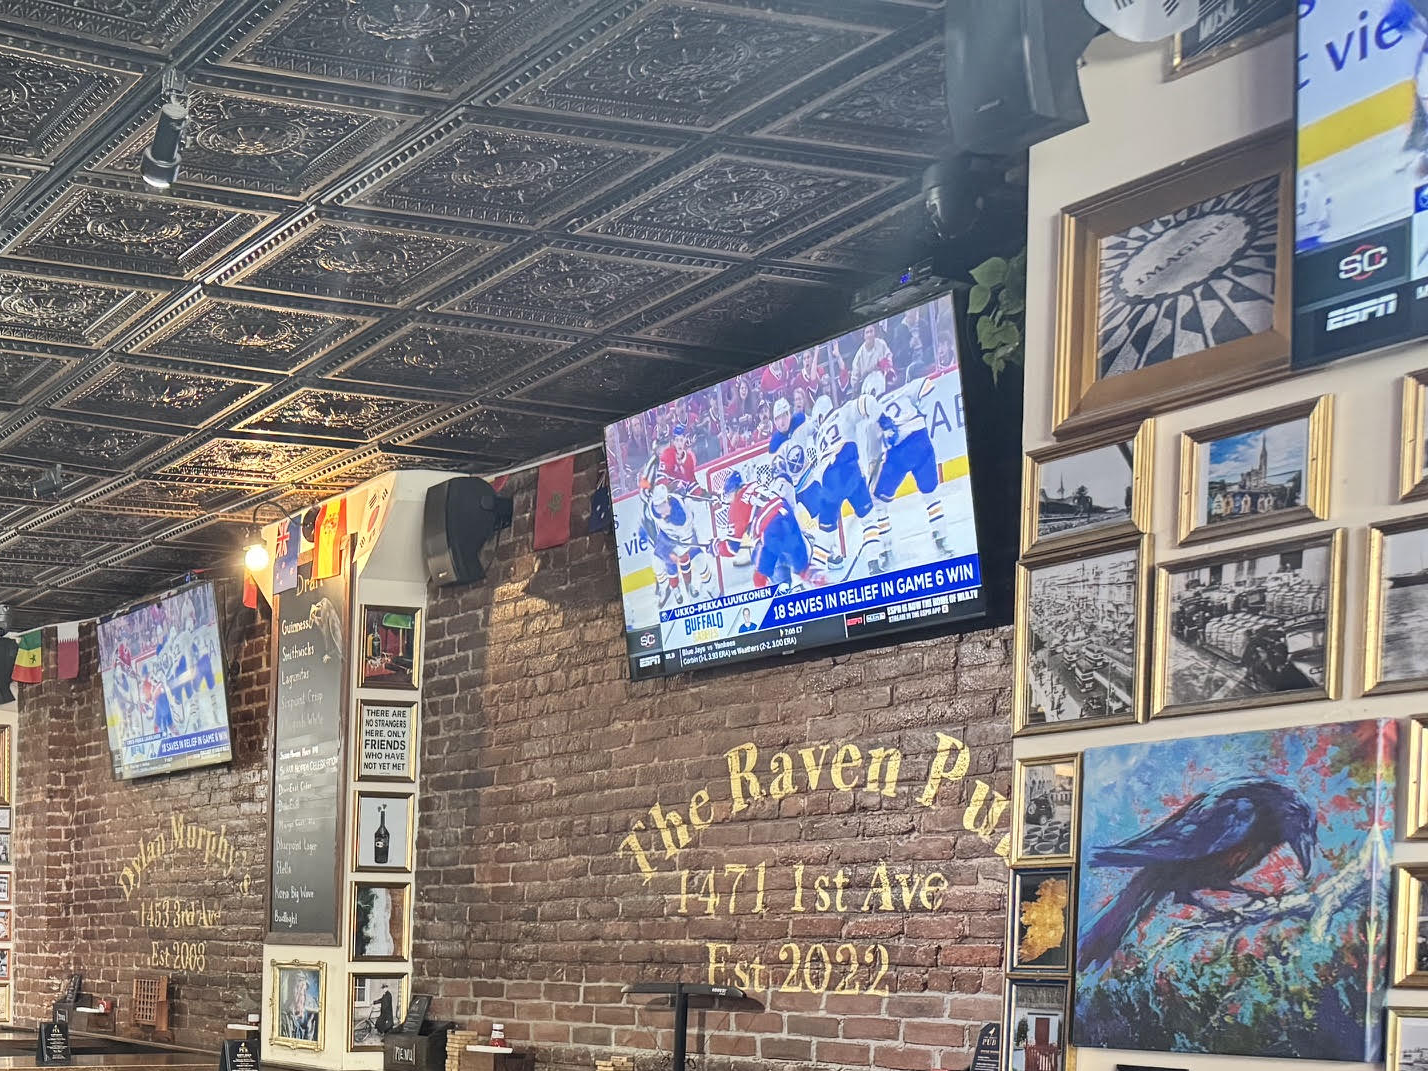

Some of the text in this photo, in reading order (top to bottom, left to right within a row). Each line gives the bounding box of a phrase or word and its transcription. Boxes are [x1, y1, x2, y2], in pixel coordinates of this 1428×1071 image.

[1136, 221, 1232, 285] IMAGINE
[1326, 293, 1398, 331] ESPN
[674, 587, 772, 617] UKKO-PEKKA LUUKKONEN
[773, 562, 974, 620] 18 SAVES IN RELIEF IN GAME 6 WIN
[281, 619, 310, 636] Guinness
[685, 611, 724, 636] BUFFALO
[282, 642, 315, 662] Smithwicks
[639, 654, 661, 668] ESPN
[365, 719, 407, 728] NO STRANGERS
[367, 709, 407, 718] THERE ARE
[364, 739, 406, 750] FRIENDS
[387, 730, 406, 738] ONLY
[364, 752, 383, 760] WHO
[364, 762, 377, 770] NOT
[392, 763, 406, 771] MET
[616, 731, 1010, 886] The Raven Pu
[119, 833, 165, 902] Dylan
[276, 860, 292, 875] Stella
[677, 858, 949, 915] 1471 1st Ave
[140, 900, 222, 928] 1453 3rd Ave
[152, 941, 207, 972] Est 2008
[705, 942, 891, 996] Est 2022
